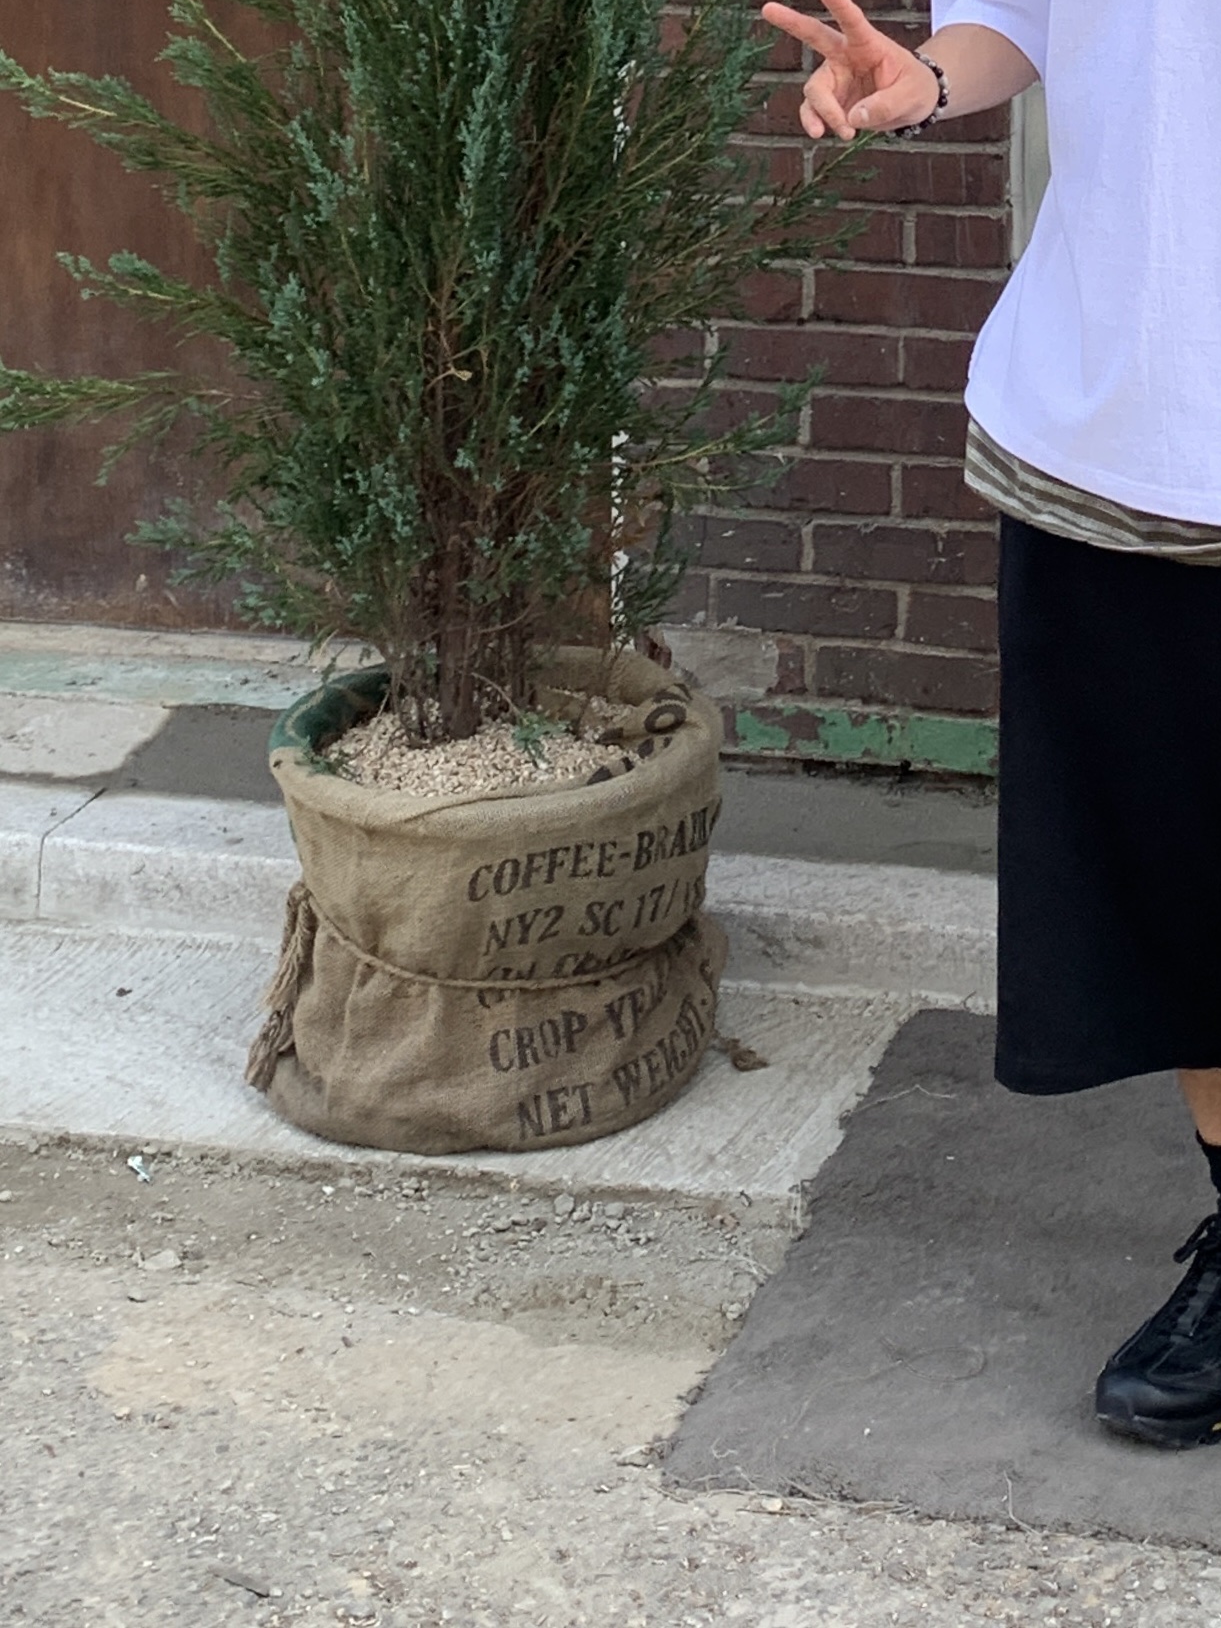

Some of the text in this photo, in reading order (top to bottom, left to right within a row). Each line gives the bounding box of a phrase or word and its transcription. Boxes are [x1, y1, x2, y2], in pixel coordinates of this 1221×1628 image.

[482, 904, 565, 957] NY2
[578, 899, 625, 937] SC
[488, 1009, 589, 1074] CROP
[516, 1081, 594, 1141] NET
